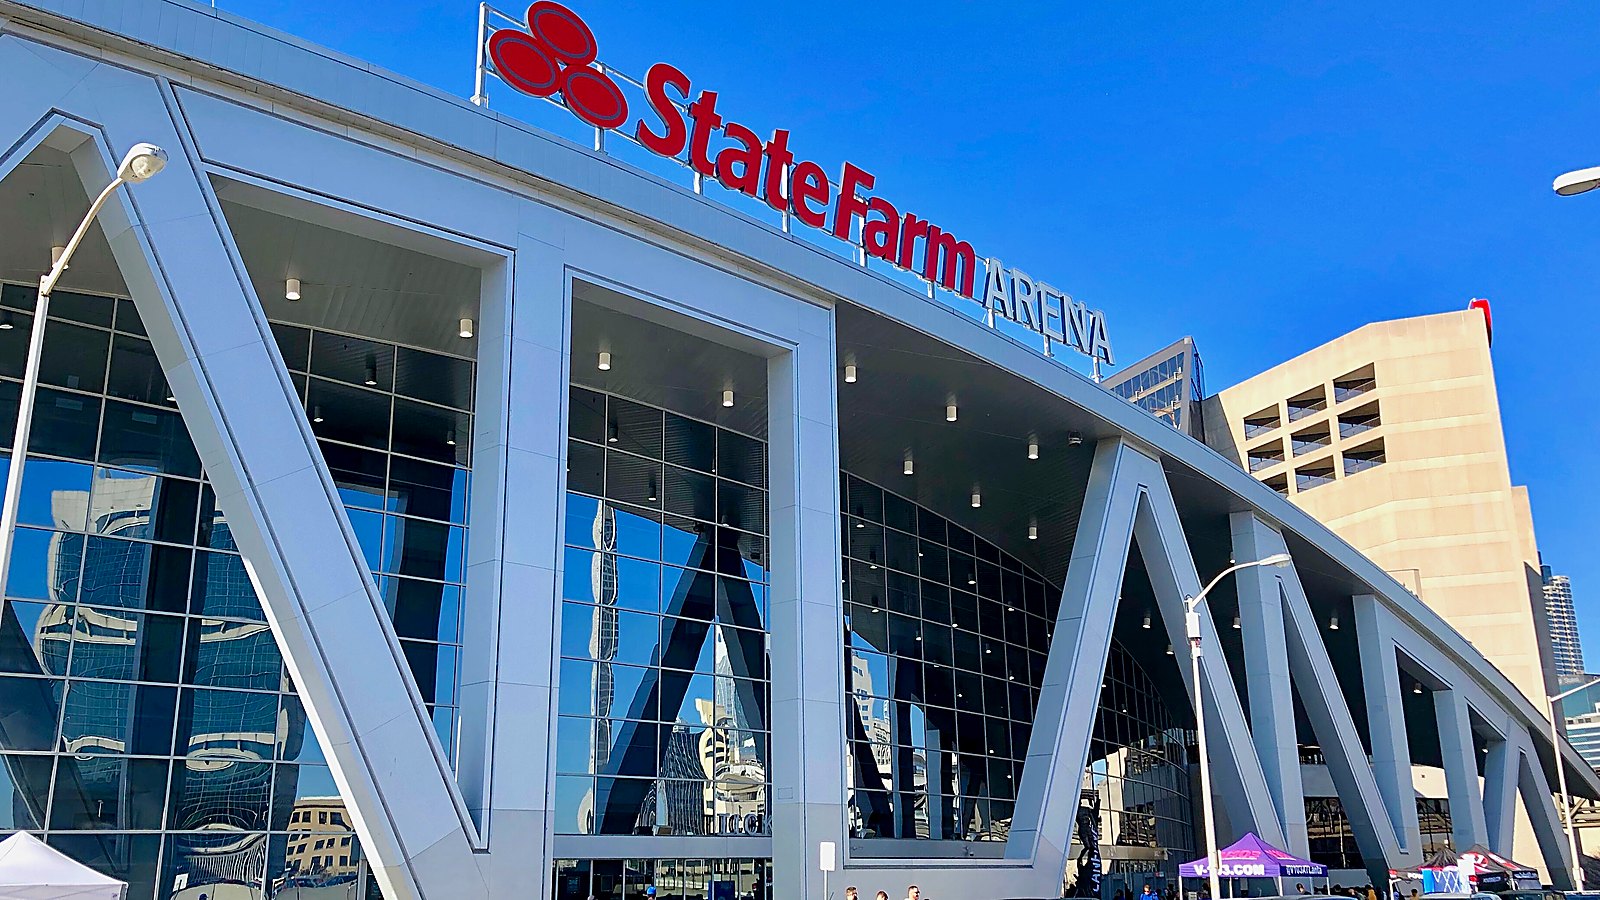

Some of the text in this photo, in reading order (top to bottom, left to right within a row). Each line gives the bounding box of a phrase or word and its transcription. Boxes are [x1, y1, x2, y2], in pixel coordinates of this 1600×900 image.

[635, 62, 1115, 366] State Farm ARENA
